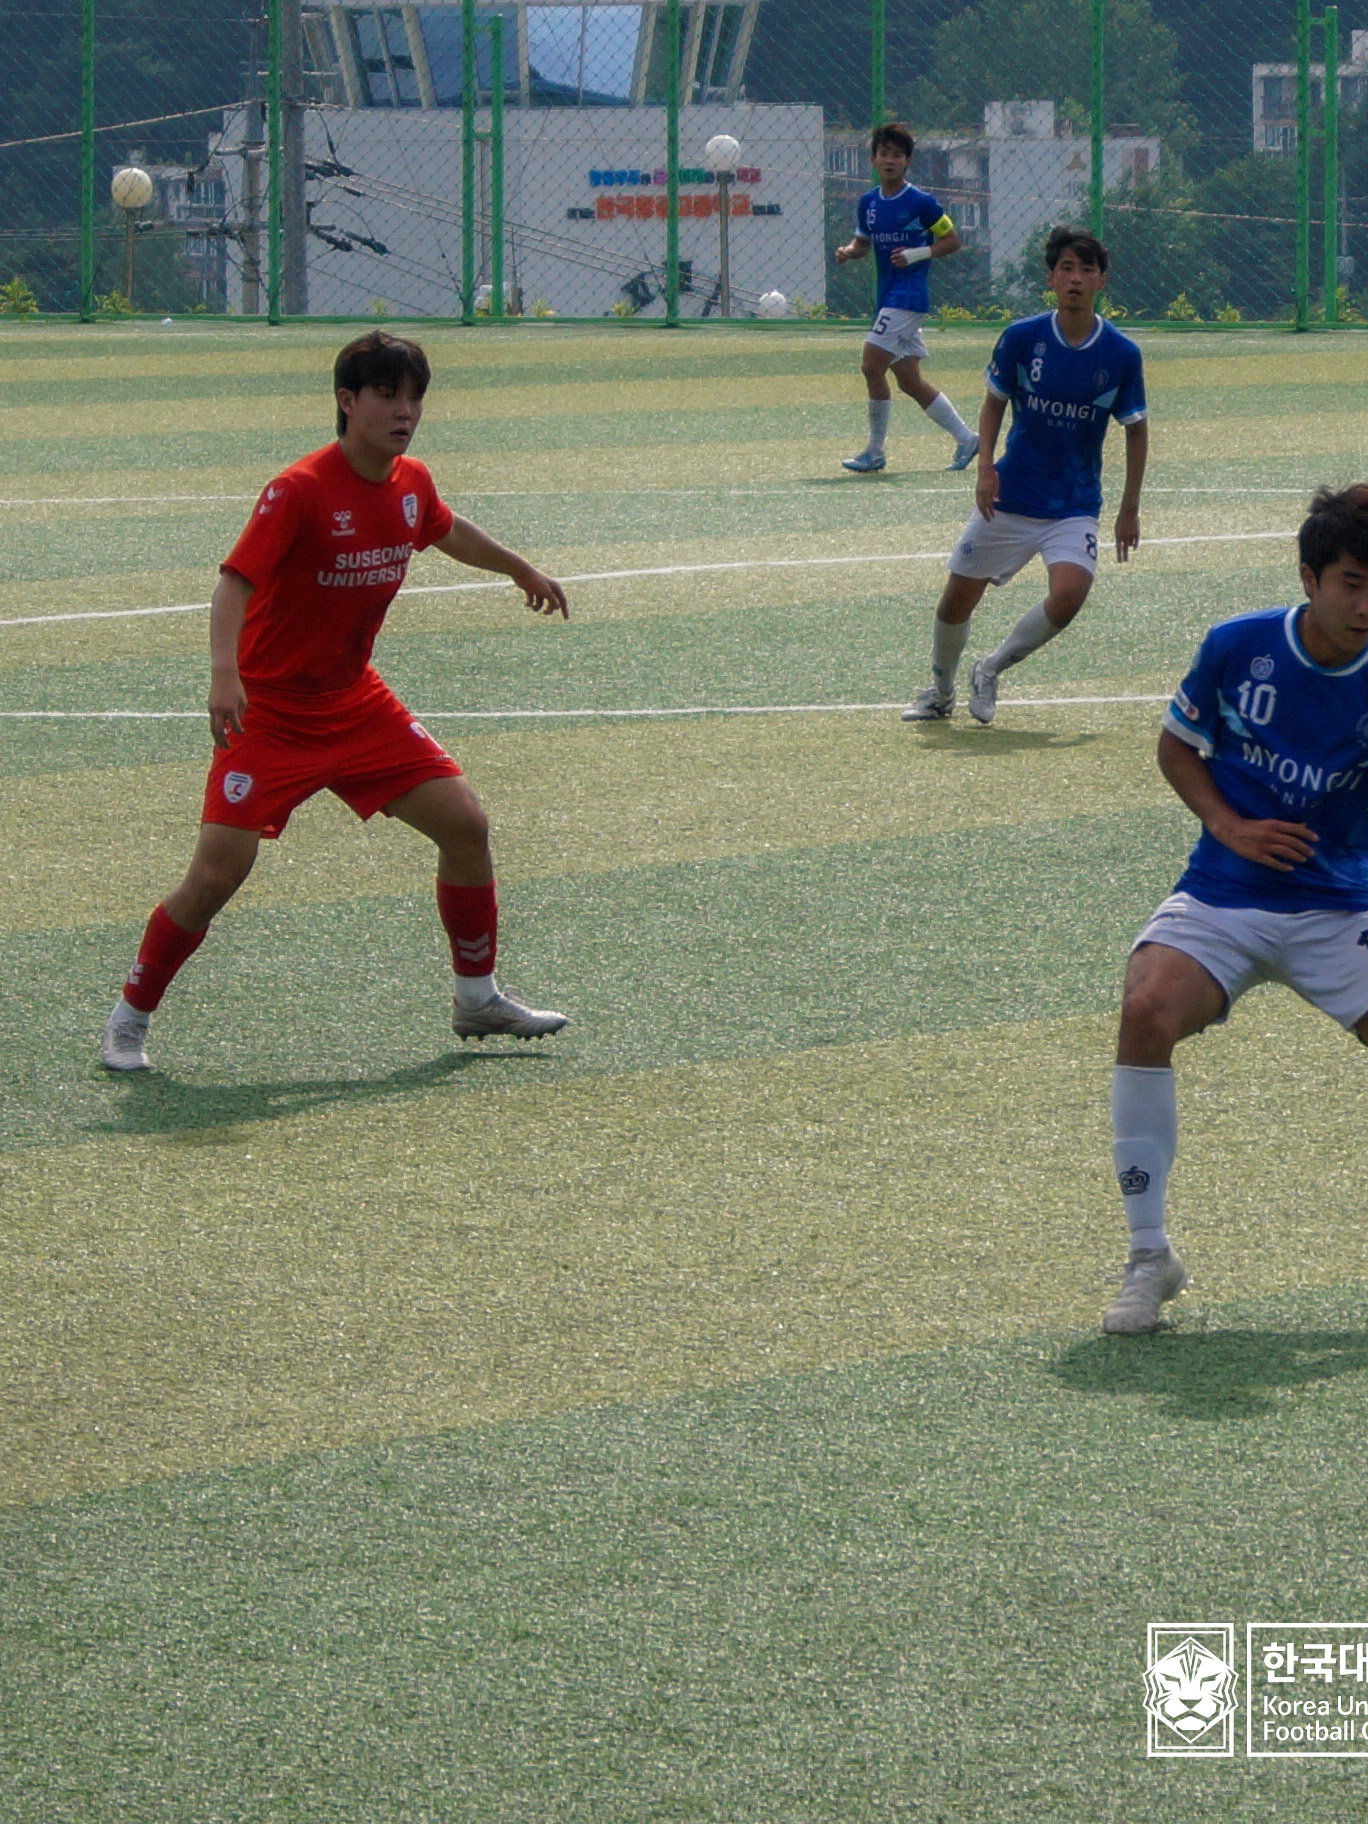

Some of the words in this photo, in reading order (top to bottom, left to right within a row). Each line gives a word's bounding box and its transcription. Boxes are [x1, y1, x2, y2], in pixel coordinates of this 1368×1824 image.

[866, 208, 877, 225] 15
[1031, 357, 1044, 382] 8
[1084, 532, 1098, 561] 8
[1237, 680, 1277, 726] 10
